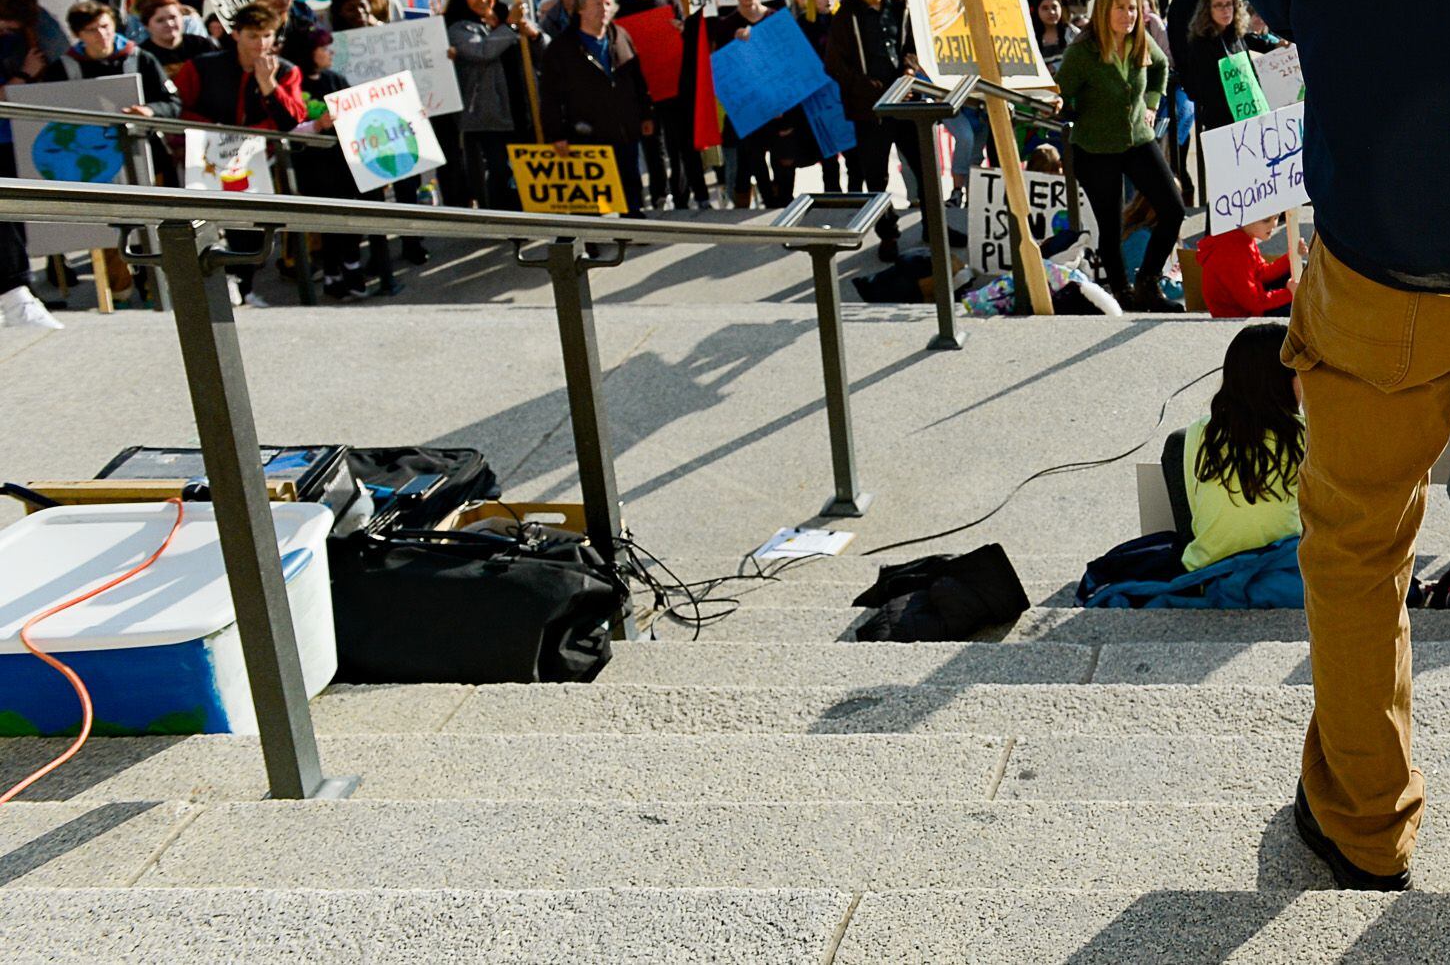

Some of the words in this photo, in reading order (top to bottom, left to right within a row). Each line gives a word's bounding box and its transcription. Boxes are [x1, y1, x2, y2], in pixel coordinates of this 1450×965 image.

[351, 27, 428, 57] SPEAK
[392, 49, 434, 71] THE
[1233, 81, 1246, 95] BE
[514, 148, 609, 159] Proect
[526, 161, 604, 180] WILD
[529, 184, 612, 203] UTAH
[1215, 165, 1281, 228] against
